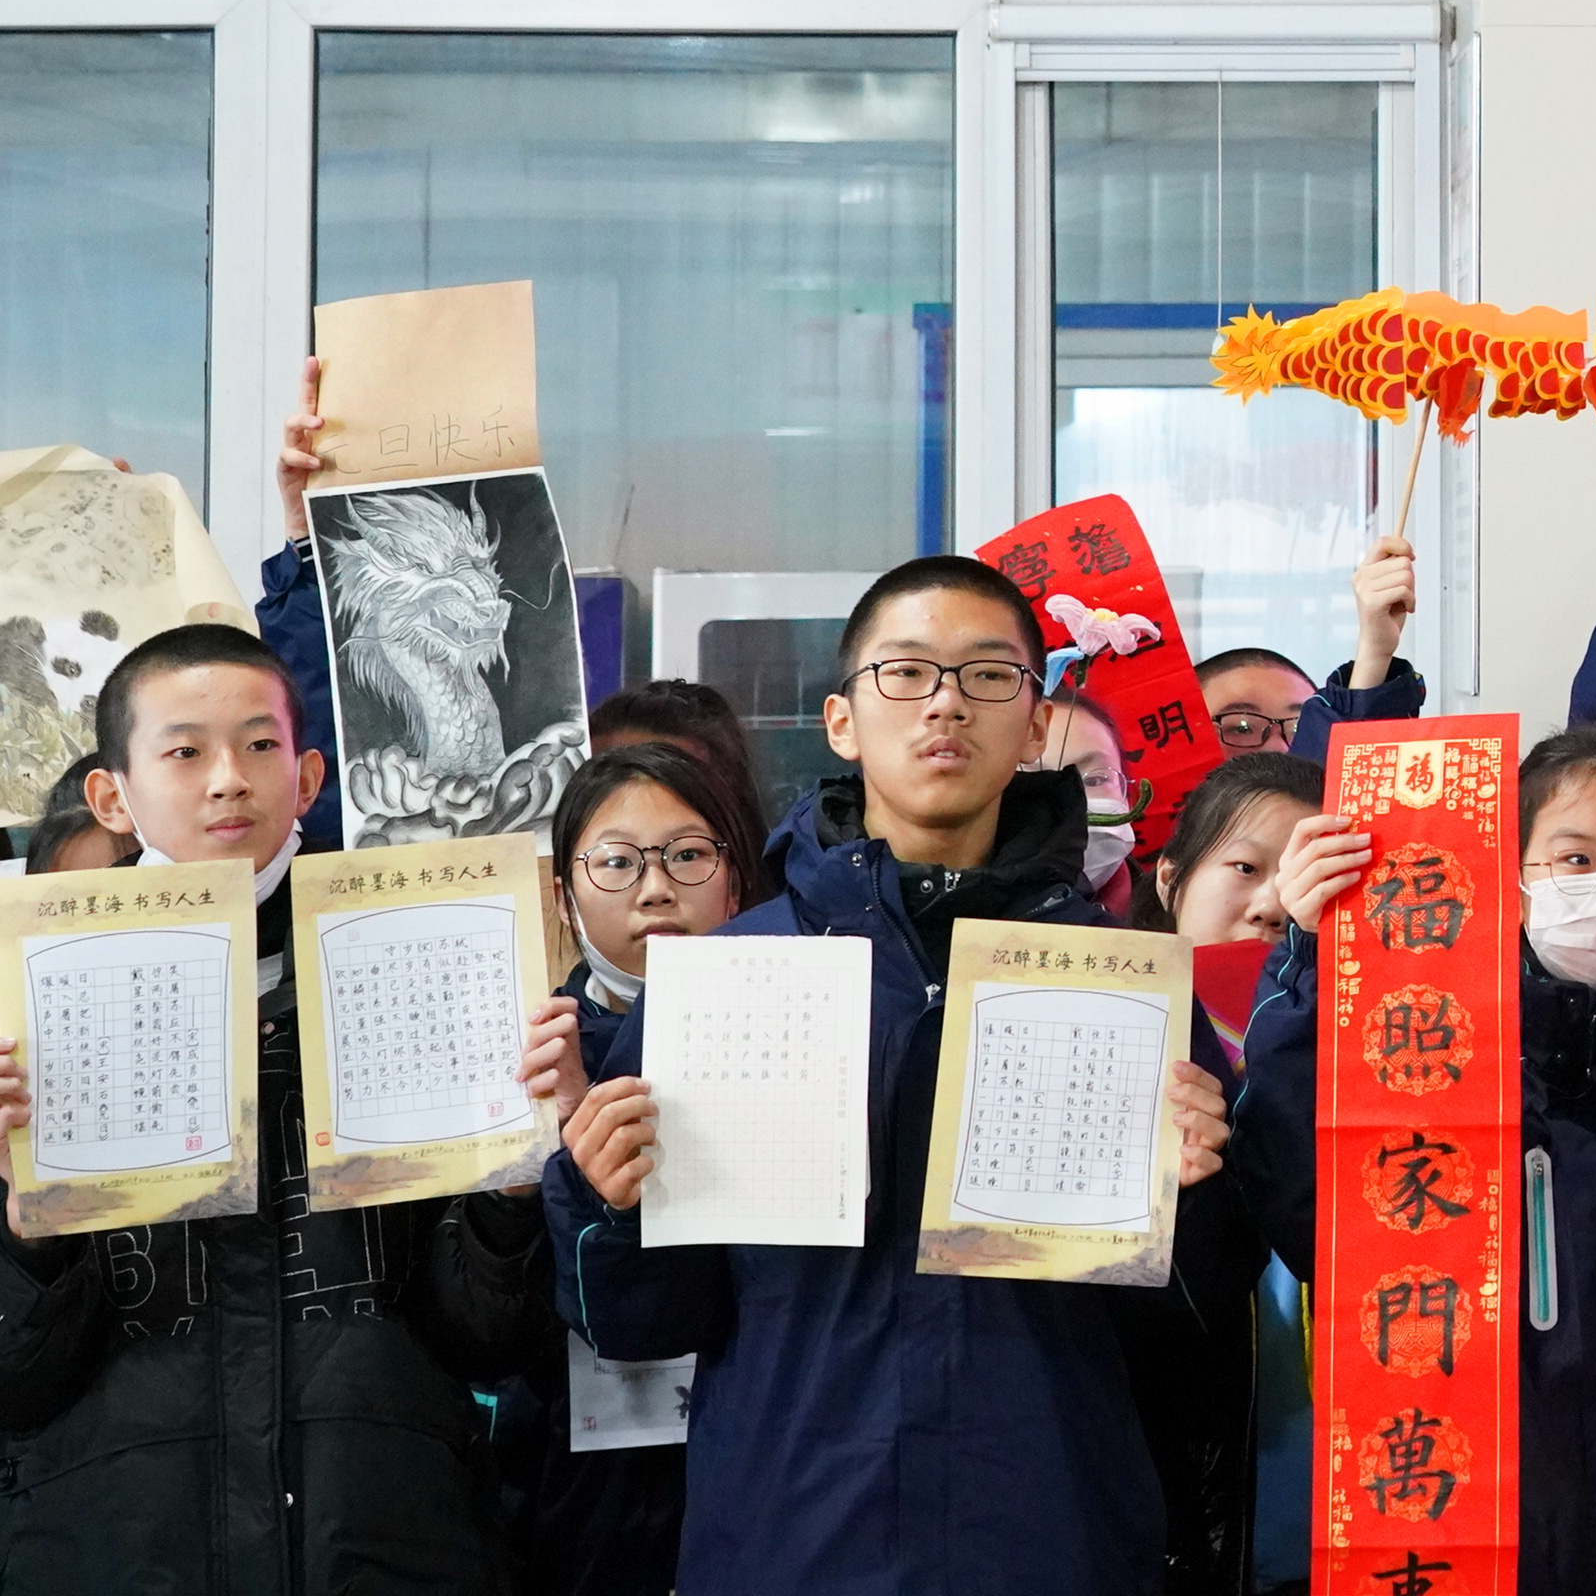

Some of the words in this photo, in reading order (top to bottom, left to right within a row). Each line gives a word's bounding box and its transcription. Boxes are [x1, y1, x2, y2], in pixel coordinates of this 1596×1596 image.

[321, 405, 515, 474] 元旦快乐
[1405, 753, 1436, 794] 福
[329, 872, 409, 895] 沉醉墨海
[418, 861, 498, 886] 书写人生
[37, 894, 124, 917] 沉醉墨海
[133, 888, 215, 913] 书写人生
[992, 949, 1074, 971] 沉醉墨海
[1082, 954, 1157, 975] 书写人生
